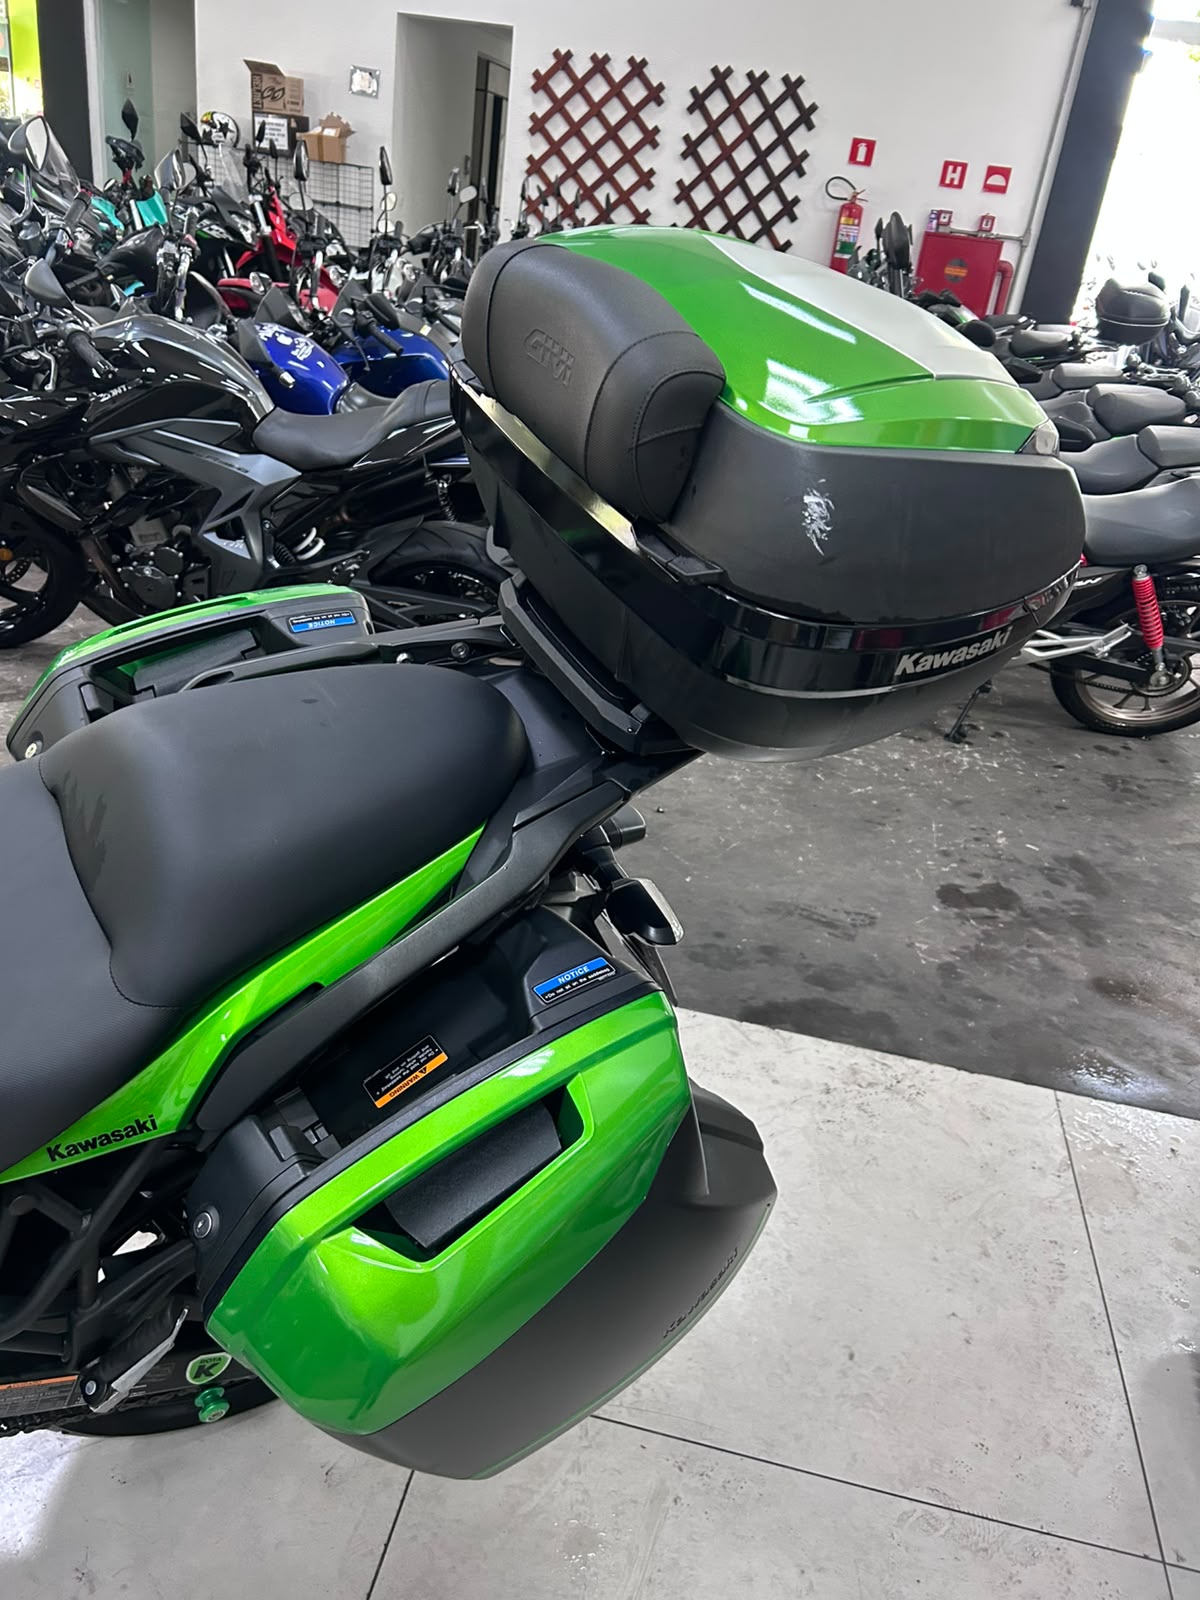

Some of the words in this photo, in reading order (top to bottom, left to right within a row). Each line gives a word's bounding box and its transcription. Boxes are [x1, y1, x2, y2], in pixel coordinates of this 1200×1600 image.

[523, 328, 576, 388] GIVI
[307, 619, 336, 628] NOTICE
[894, 625, 1014, 676] Kawasaki
[557, 965, 590, 984] NOTICE
[389, 1074, 420, 1097] WARNING
[46, 1114, 158, 1162] Kawasaki
[193, 1362, 221, 1379] K
